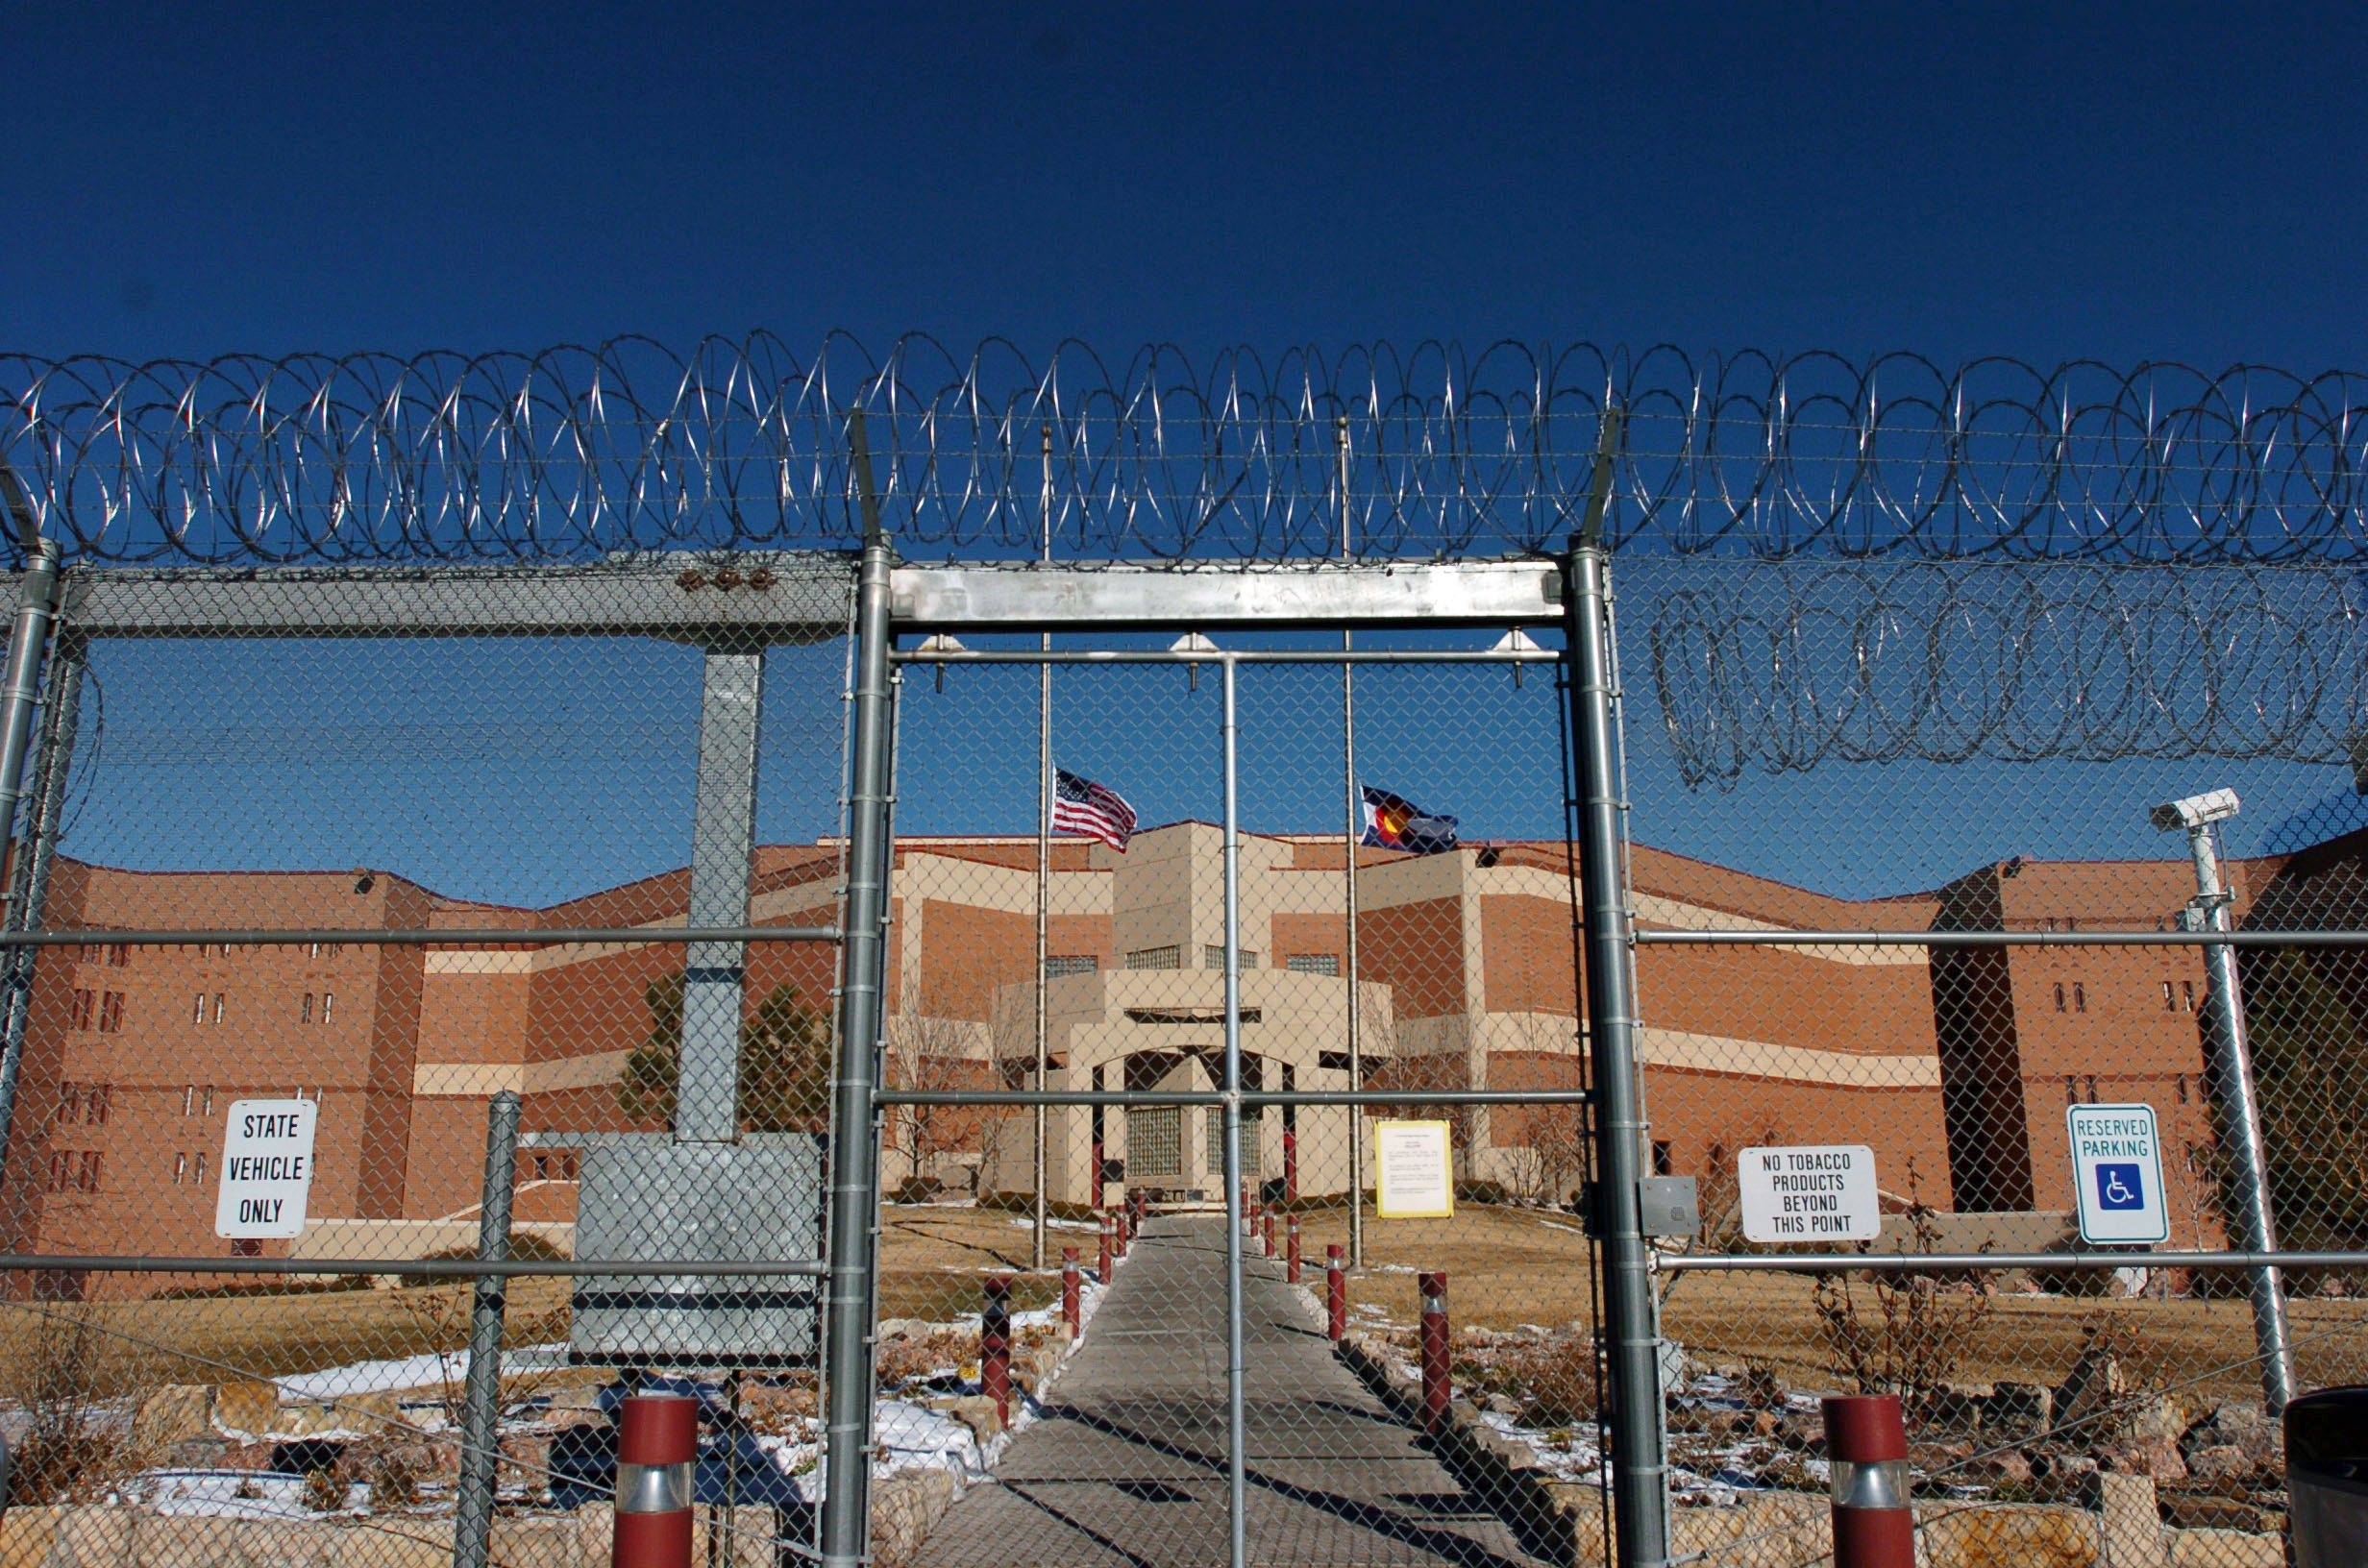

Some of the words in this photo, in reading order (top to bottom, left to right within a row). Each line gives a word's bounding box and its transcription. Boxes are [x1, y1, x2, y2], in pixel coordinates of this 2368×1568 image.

[243, 1115, 299, 1138] STATE
[2077, 1119, 2148, 1136] RESERVED
[2083, 1140, 2148, 1157] PARKING
[231, 1157, 304, 1181] VEHICLE
[1763, 1154, 1781, 1171] NO
[1788, 1153, 1851, 1170] TOBACCO
[1772, 1174, 1844, 1191] PRODUCTS
[239, 1199, 283, 1223] ONLY
[1784, 1195, 1838, 1213] BEYOND
[1772, 1216, 1804, 1234] THIS
[1812, 1214, 1852, 1233] POINT
